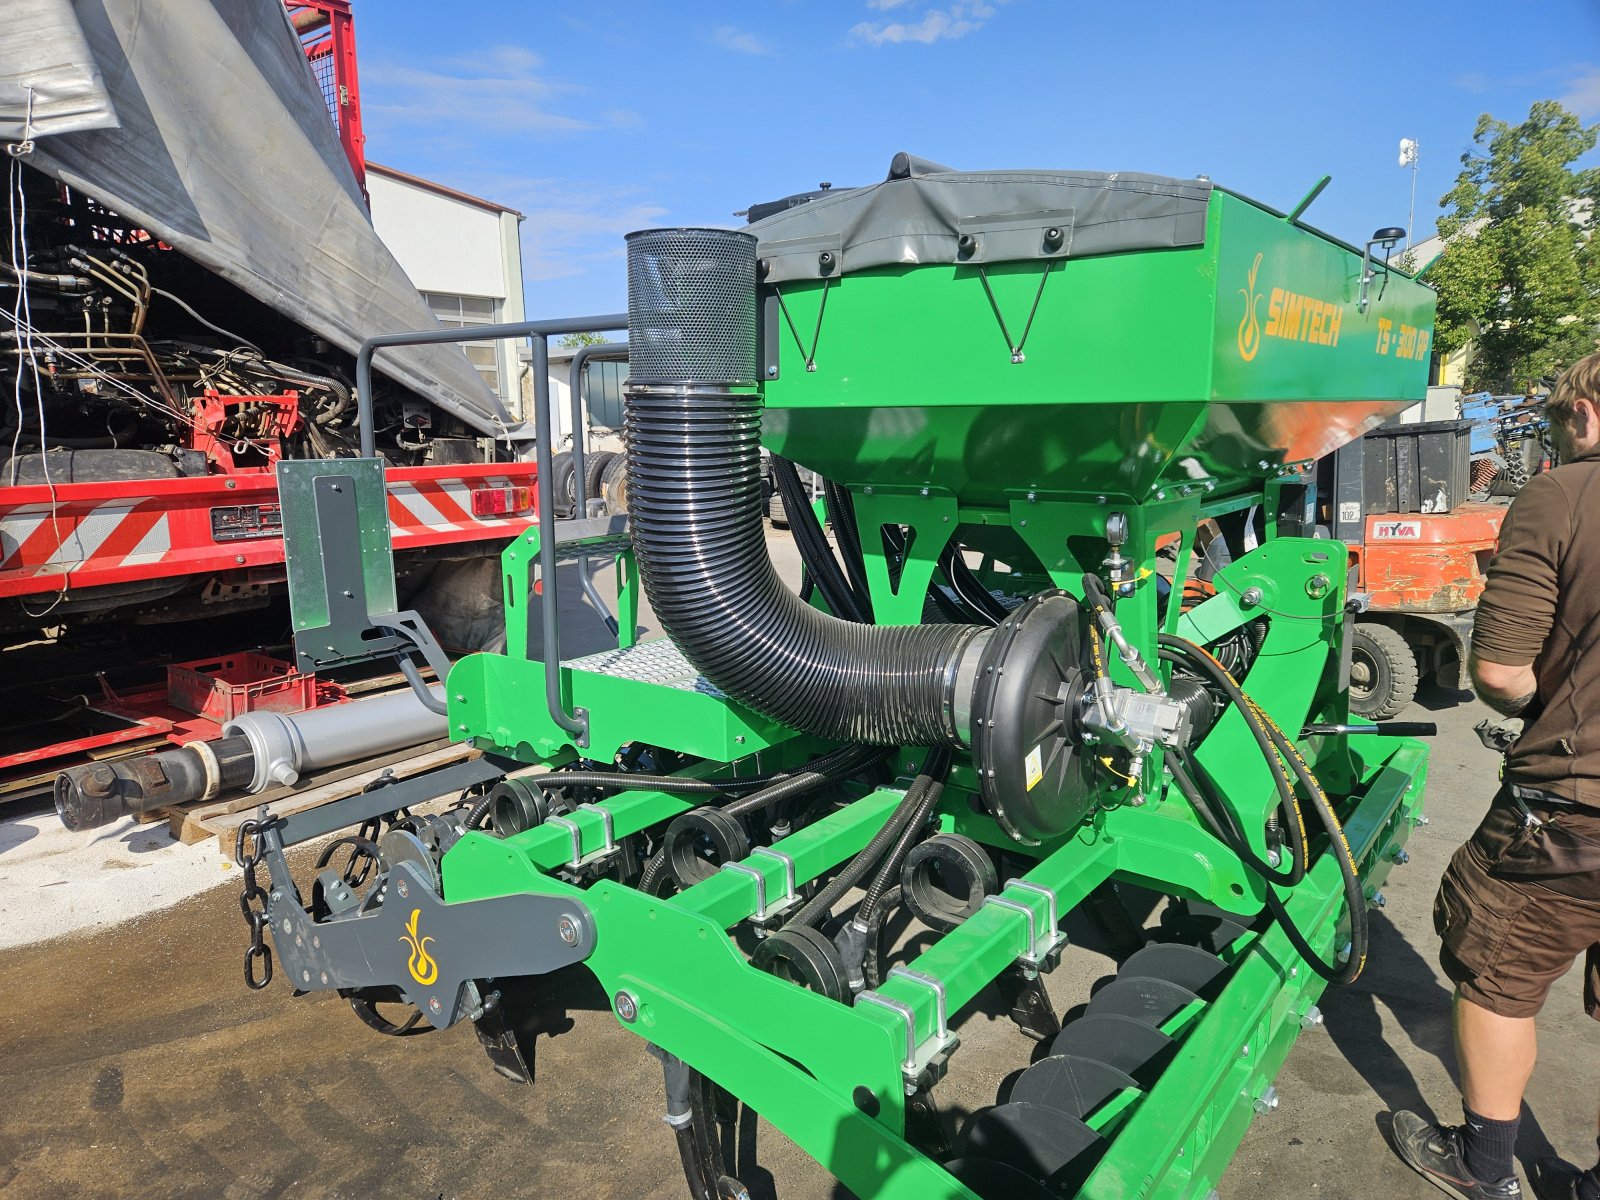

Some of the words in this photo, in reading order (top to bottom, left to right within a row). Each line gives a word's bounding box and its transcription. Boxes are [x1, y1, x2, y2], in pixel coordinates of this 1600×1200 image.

[1265, 287, 1343, 347] SIMTECH
[1376, 317, 1392, 355] TS
[1396, 324, 1416, 359] 300
[1415, 330, 1429, 361] AP
[1342, 511, 1354, 521] 102
[1378, 522, 1416, 537] HYVA
